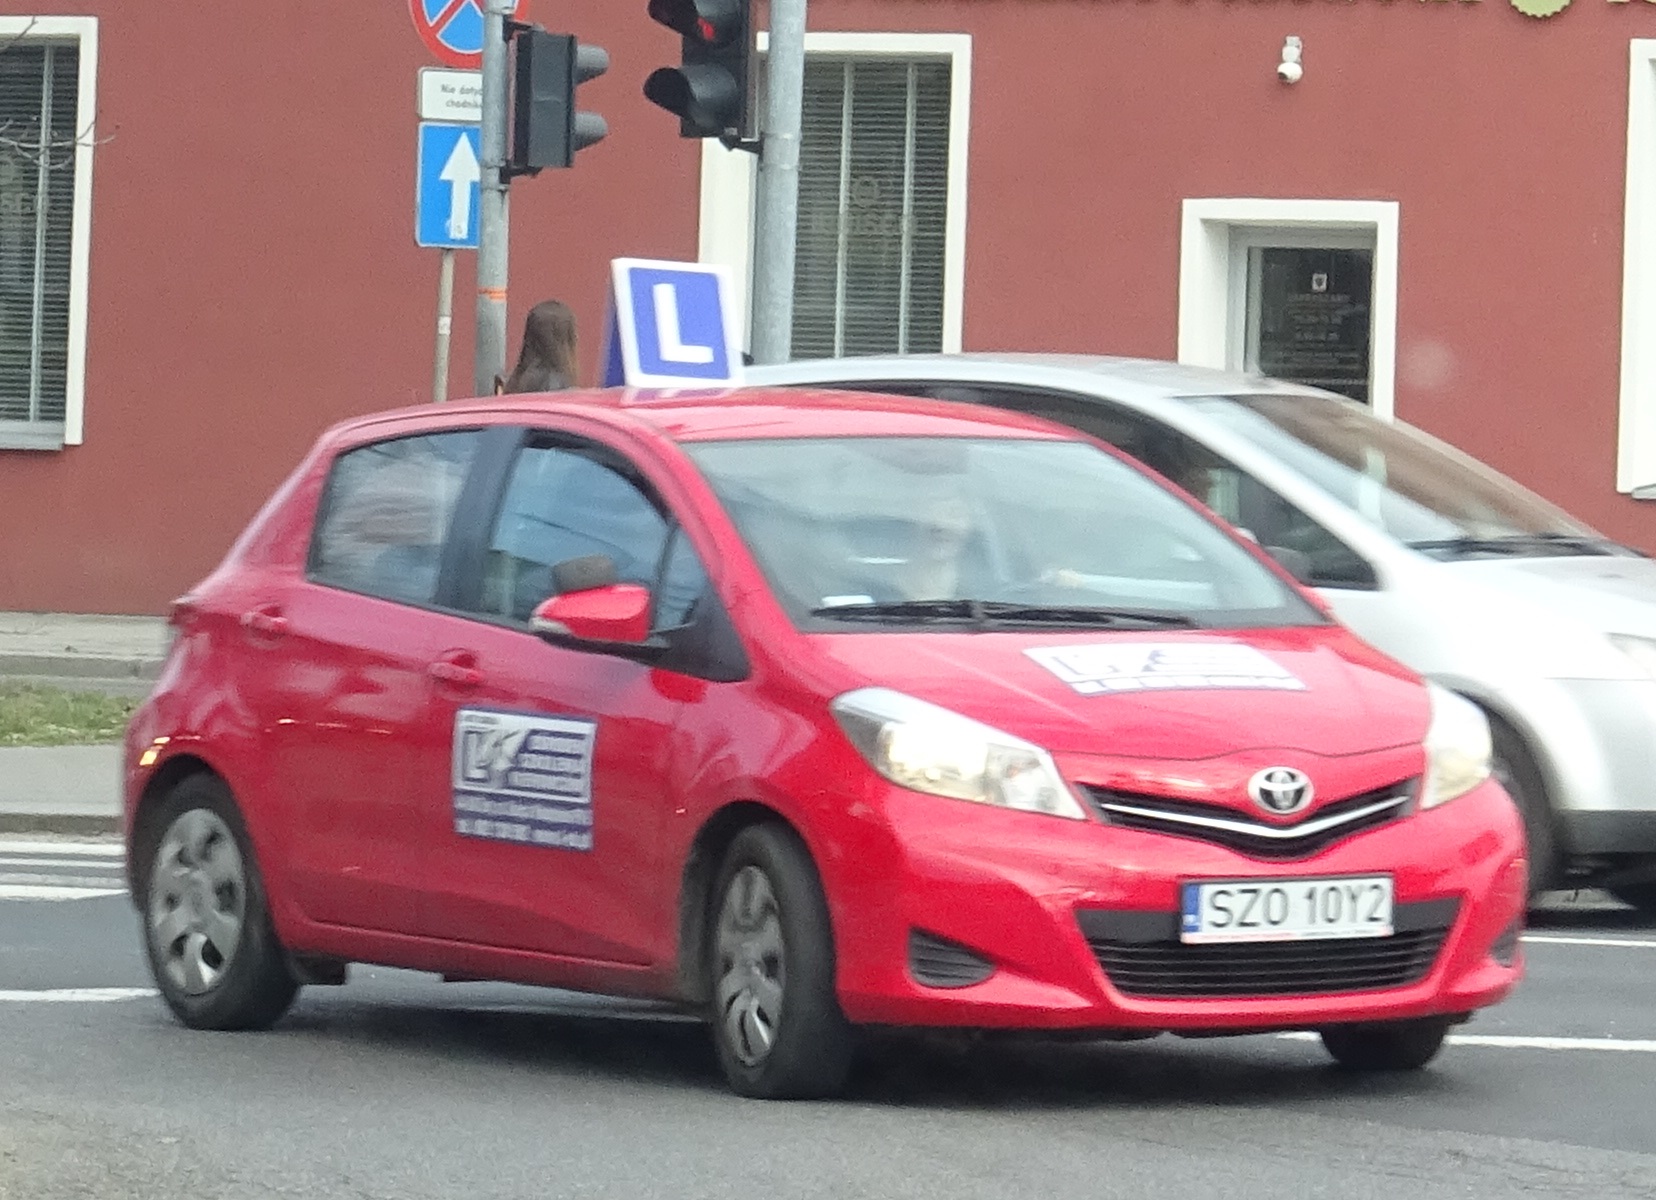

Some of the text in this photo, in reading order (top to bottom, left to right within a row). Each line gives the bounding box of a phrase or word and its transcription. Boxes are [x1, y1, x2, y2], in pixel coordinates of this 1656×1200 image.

[653, 283, 714, 364] L
[1208, 883, 1386, 929] SZO 10Y2
